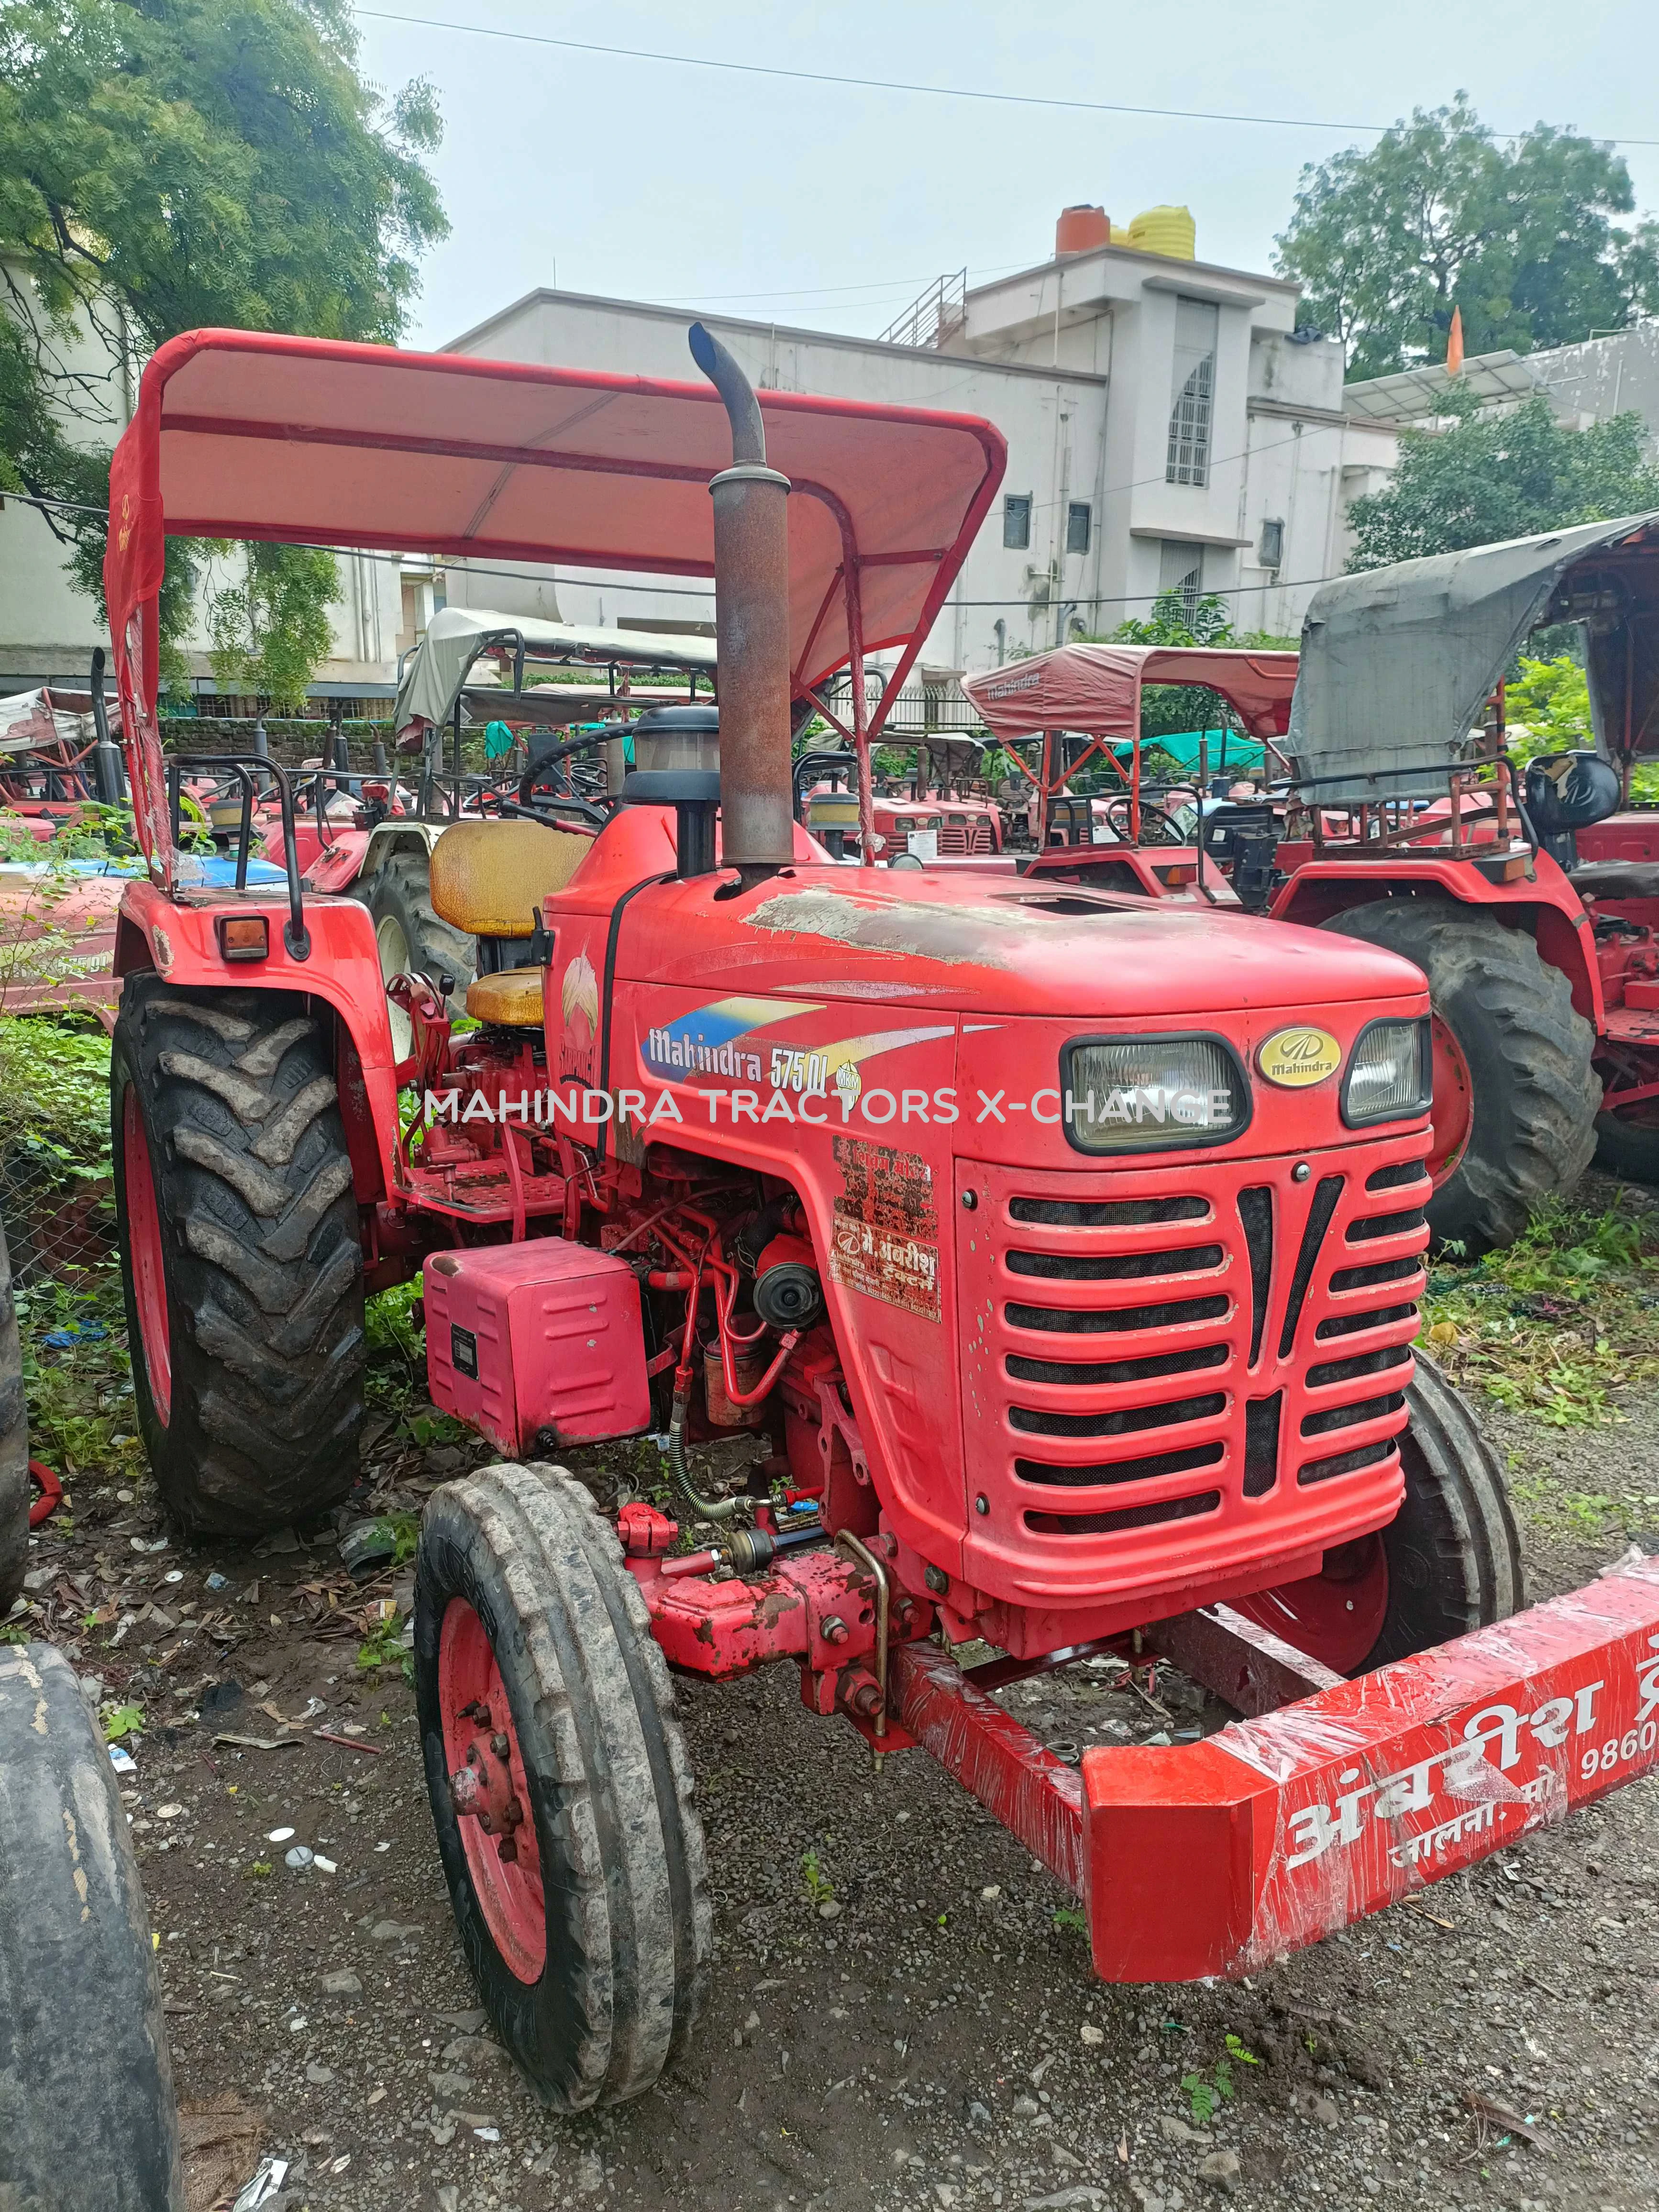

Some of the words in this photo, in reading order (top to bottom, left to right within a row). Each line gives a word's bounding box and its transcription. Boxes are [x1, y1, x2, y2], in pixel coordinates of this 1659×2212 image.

[649, 1028, 762, 1083] Mahindra
[770, 1048, 806, 1093] 575
[837, 1069, 860, 1090] MKM
[1272, 1061, 1332, 1076] Mahindra
[879, 1235, 935, 1276] अंबरीश
[1287, 1680, 1604, 1871] अंबरीश
[1581, 1721, 1657, 1780] 9860
